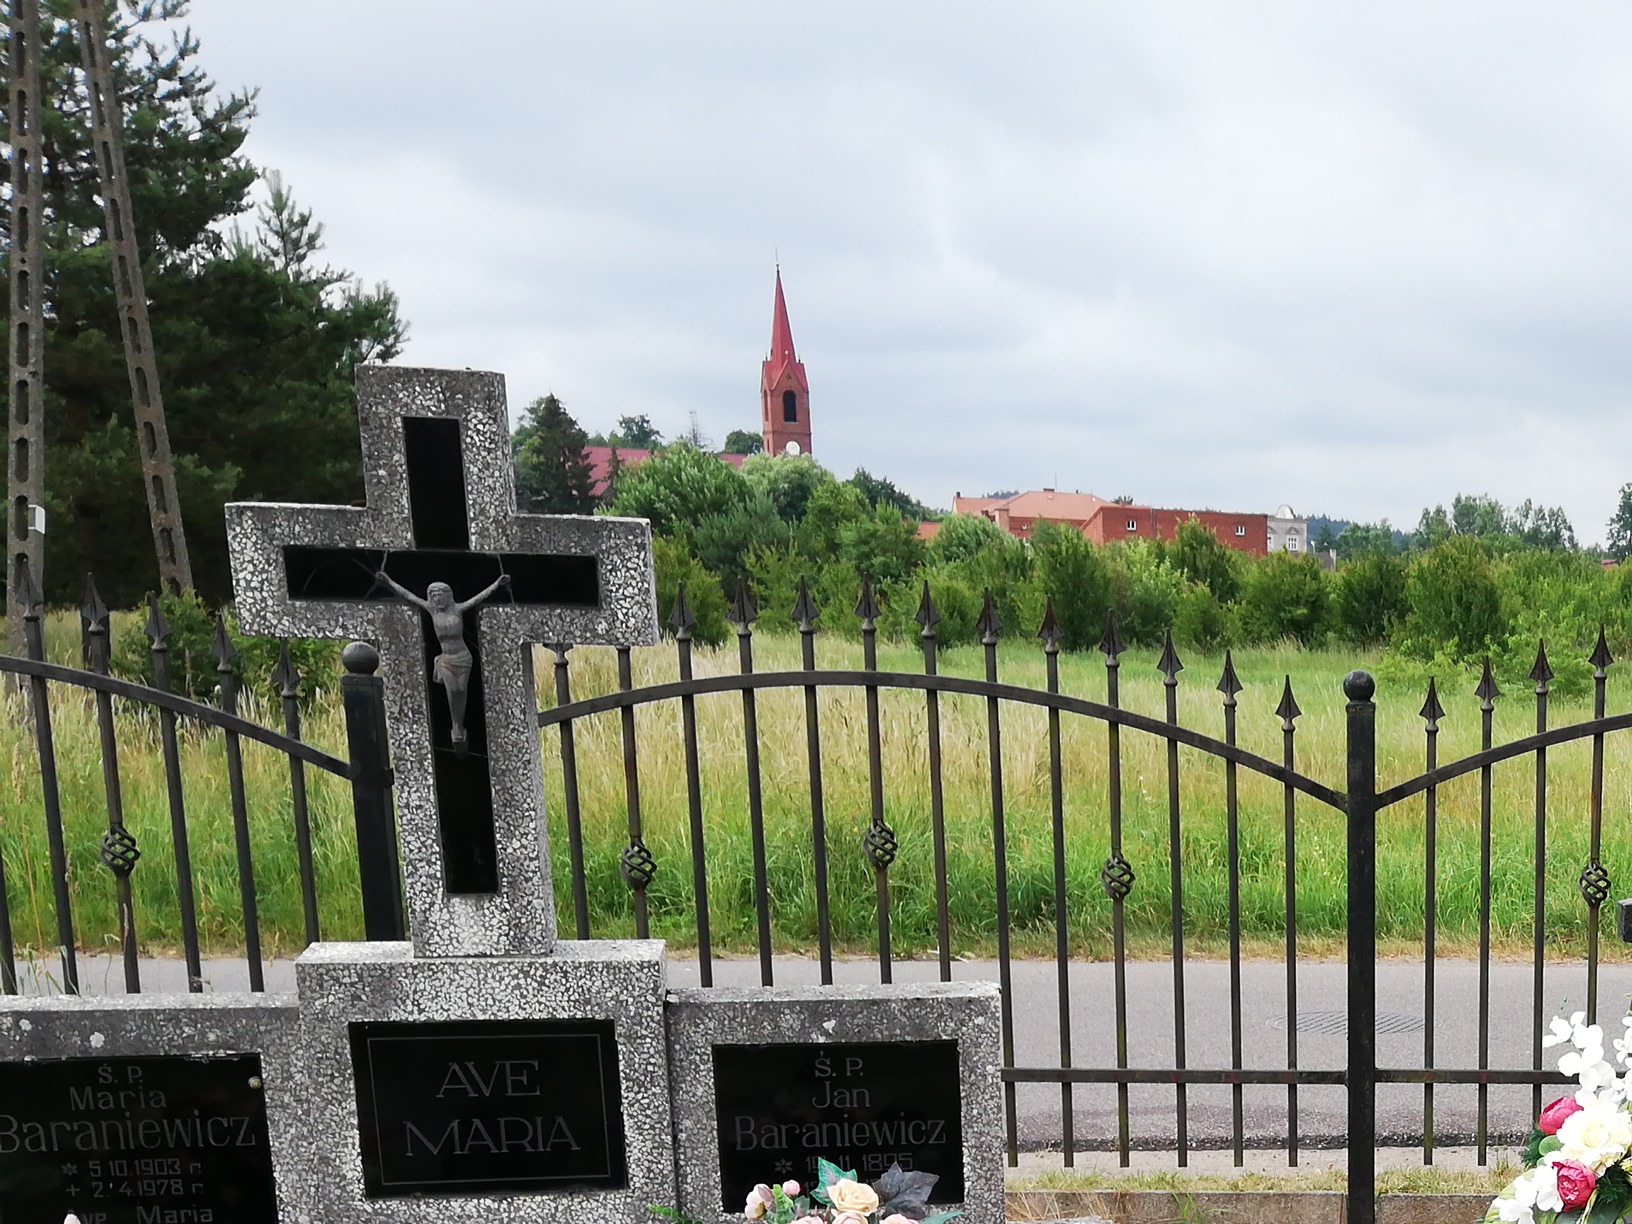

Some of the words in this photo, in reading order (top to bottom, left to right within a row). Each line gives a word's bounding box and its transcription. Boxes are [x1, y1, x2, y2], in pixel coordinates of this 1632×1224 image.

[436, 1060, 540, 1098] AVE
[846, 1057, 864, 1077] P.
[69, 1086, 167, 1111] Maria
[812, 1080, 871, 1108] Jan
[0, 1109, 256, 1154] Baraniewicz
[403, 1116, 581, 1156] MARIA
[734, 1112, 946, 1151] Baraniewicz
[136, 1204, 213, 1224] Maria
